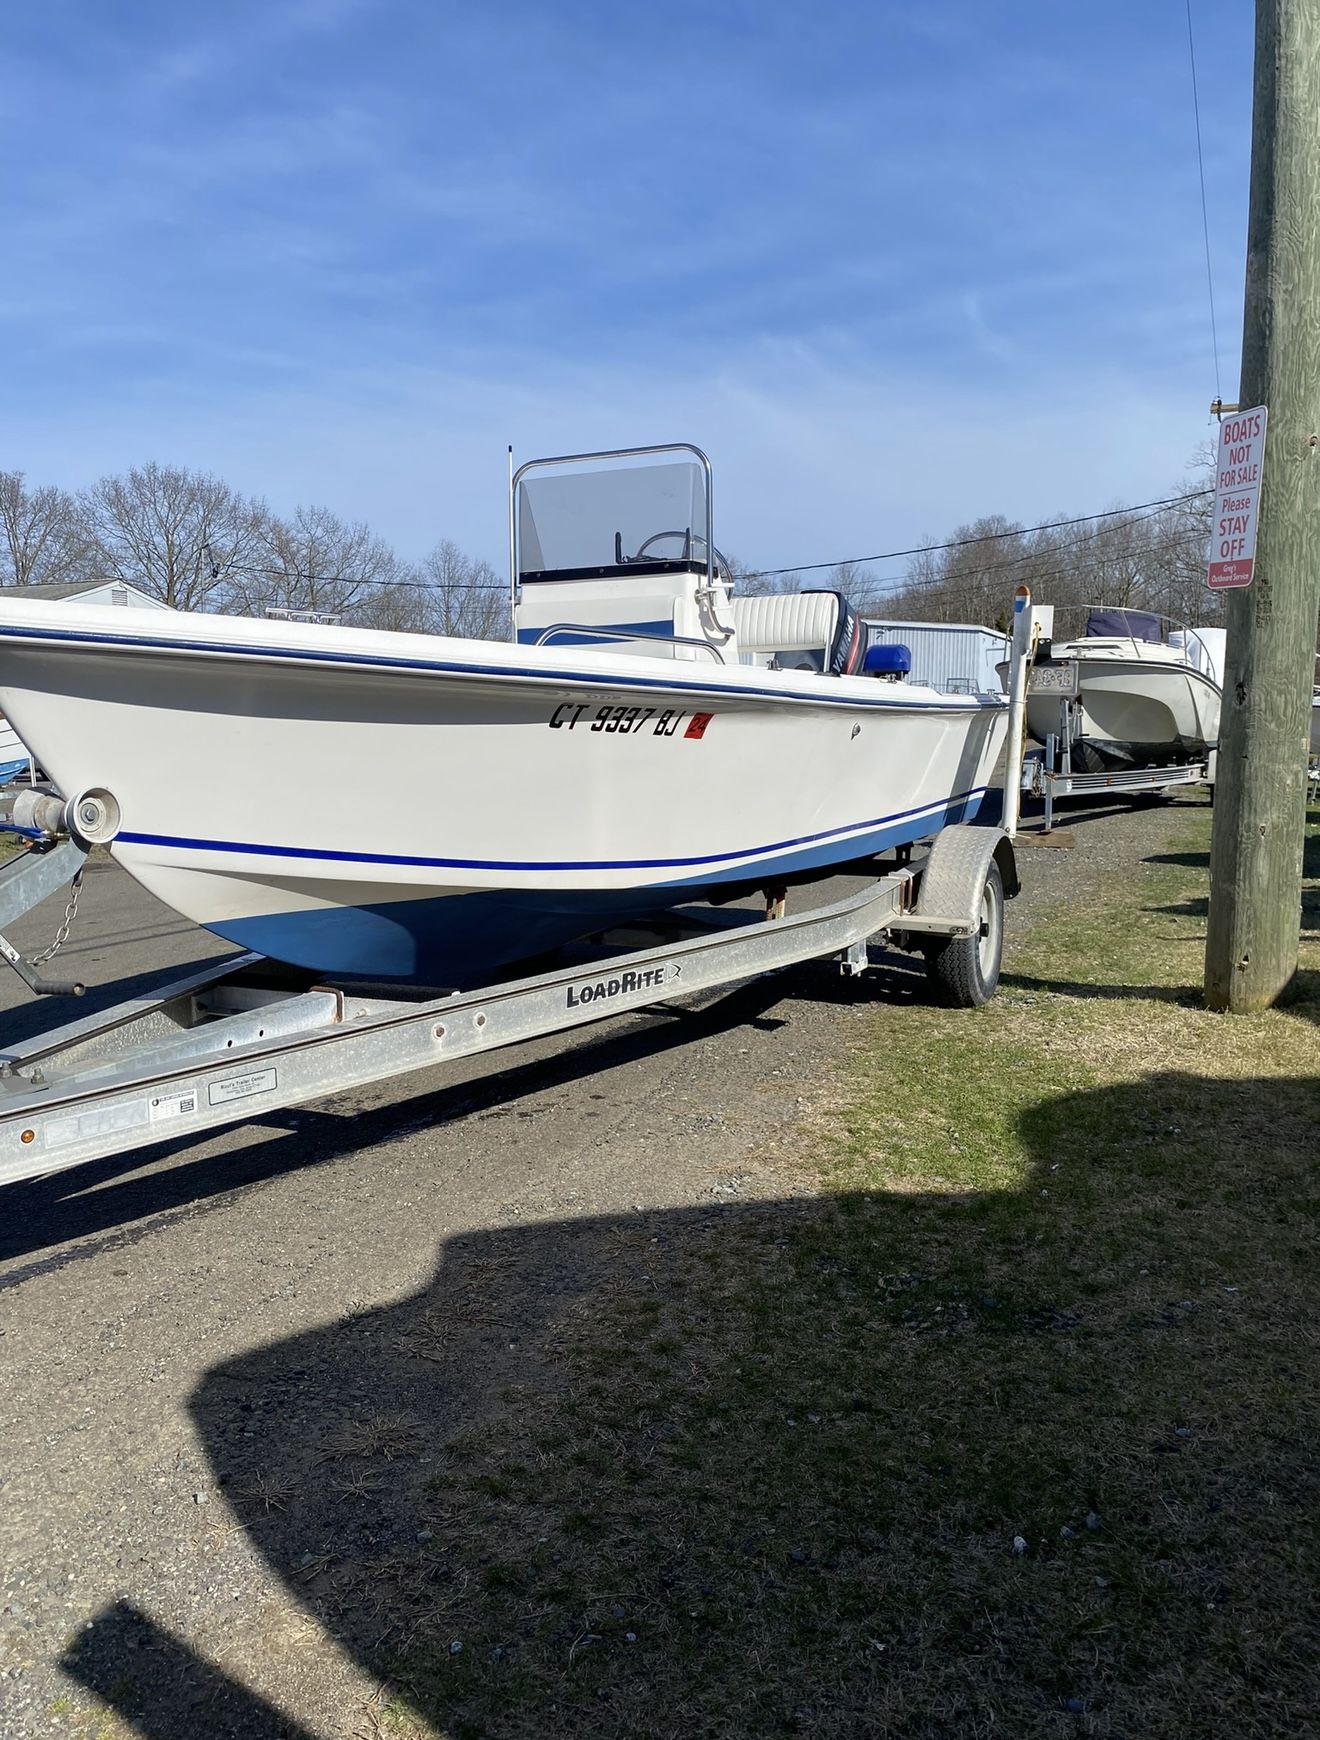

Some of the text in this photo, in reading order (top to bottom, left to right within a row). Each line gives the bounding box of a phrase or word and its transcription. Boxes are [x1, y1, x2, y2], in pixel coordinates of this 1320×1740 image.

[1224, 415, 1260, 445] BOATS
[1229, 443, 1252, 466] NOT
[1220, 463, 1258, 488] FOR SALE
[1222, 496, 1251, 513] Please
[1219, 514, 1250, 537] STAY
[1220, 537, 1245, 559] OFF
[1211, 572, 1249, 583] Outboard Service
[832, 615, 854, 673] YAMAHA
[548, 702, 687, 737] CT 9337 BJ
[687, 716, 708, 733] 24
